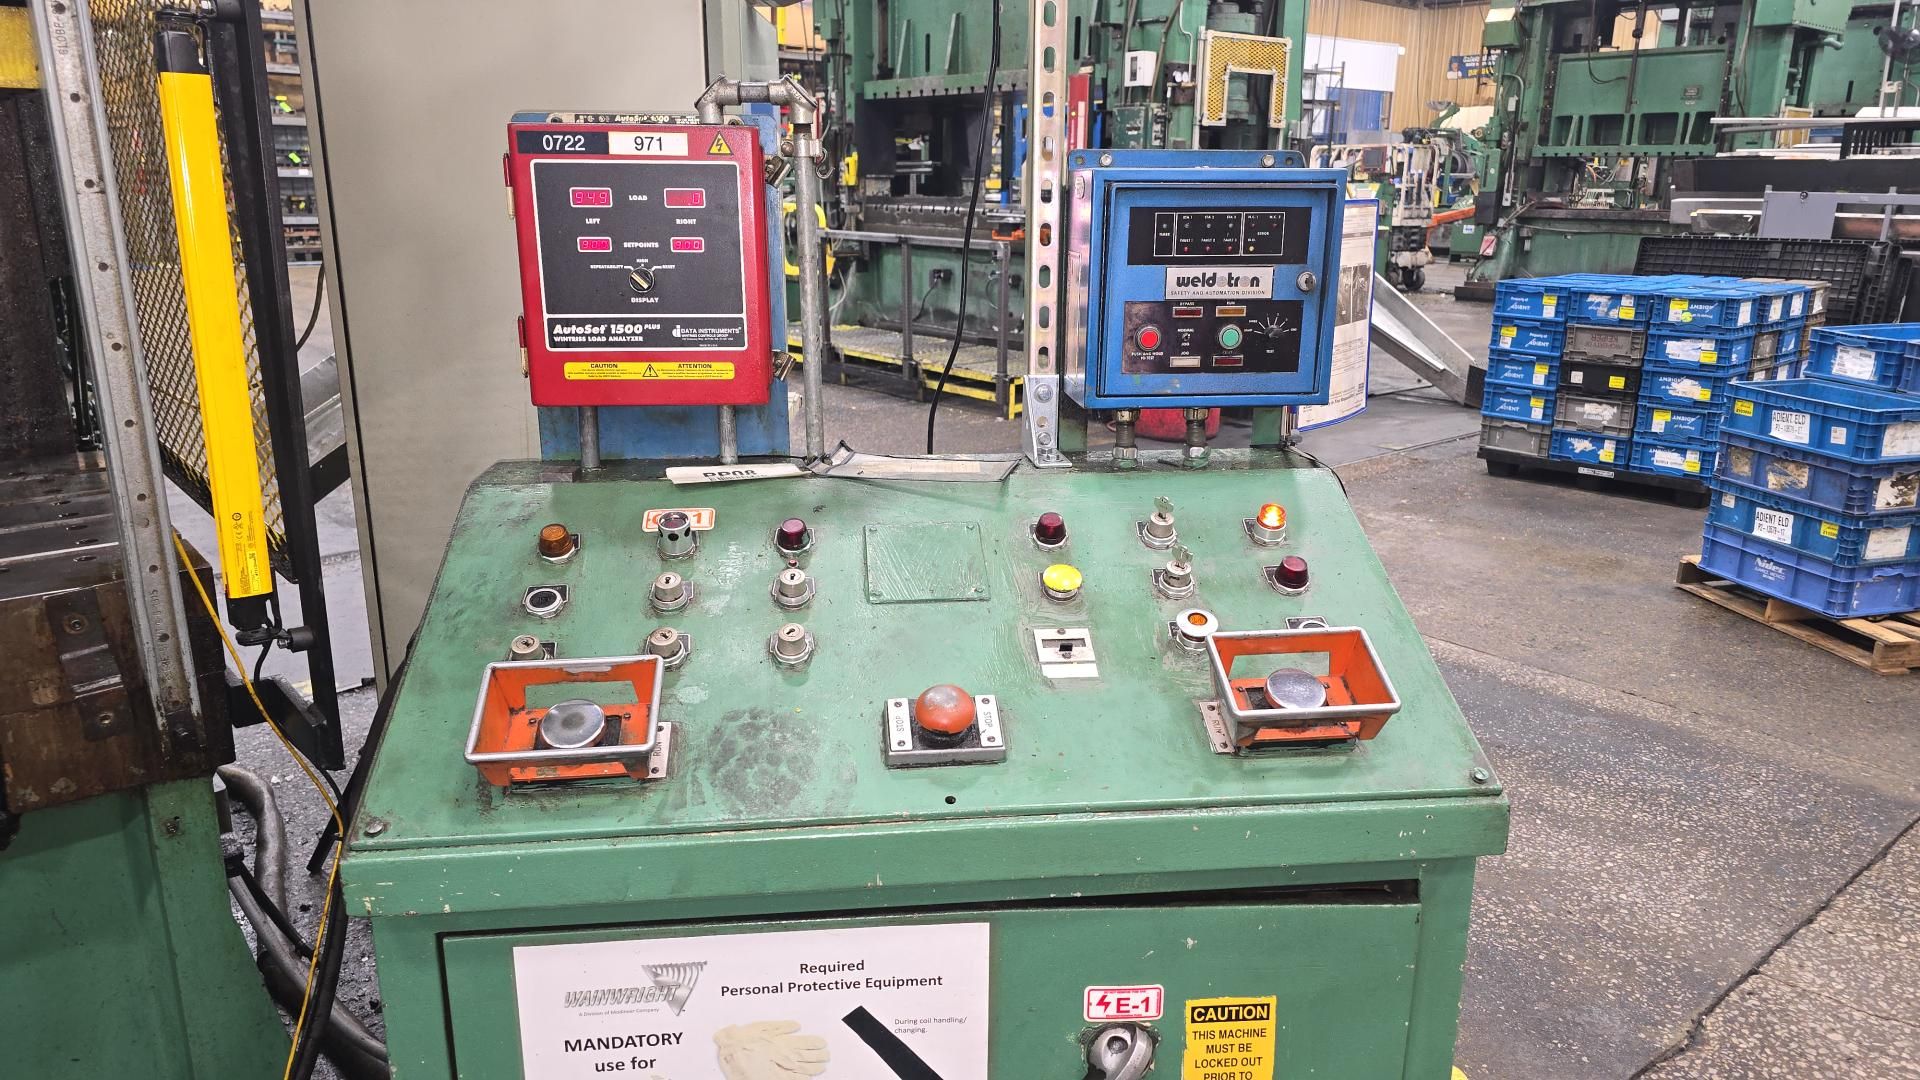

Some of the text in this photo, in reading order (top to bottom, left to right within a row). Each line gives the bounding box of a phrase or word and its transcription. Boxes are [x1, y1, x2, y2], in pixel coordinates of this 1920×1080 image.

[543, 135, 585, 151] 0722
[634, 137, 663, 151] 971
[610, 324, 643, 334] 1500
[1772, 411, 1806, 425] ADIENT ELD
[1756, 512, 1789, 527] ADIENT ELD
[896, 716, 905, 732] STOP
[984, 711, 993, 727] STOP
[653, 741, 662, 756] RUN
[800, 960, 865, 974] Required
[721, 975, 943, 996] Personal Protective Equipment
[564, 984, 681, 1008] WAINWRIGHT
[1116, 997, 1150, 1013] E-1
[894, 1018, 918, 1026] During
[934, 1016, 968, 1025] handling/
[1193, 1006, 1268, 1022] CAUTION
[894, 1026, 928, 1035] changing.
[1192, 1028, 1267, 1041] THIS MACHINE
[564, 1032, 684, 1052] MANDATORY
[1206, 1043, 1252, 1054] MUST BE
[595, 1056, 657, 1073] use for
[1195, 1056, 1263, 1069] LOCKED OUT
[1204, 1071, 1253, 1080] PRIOR TO
